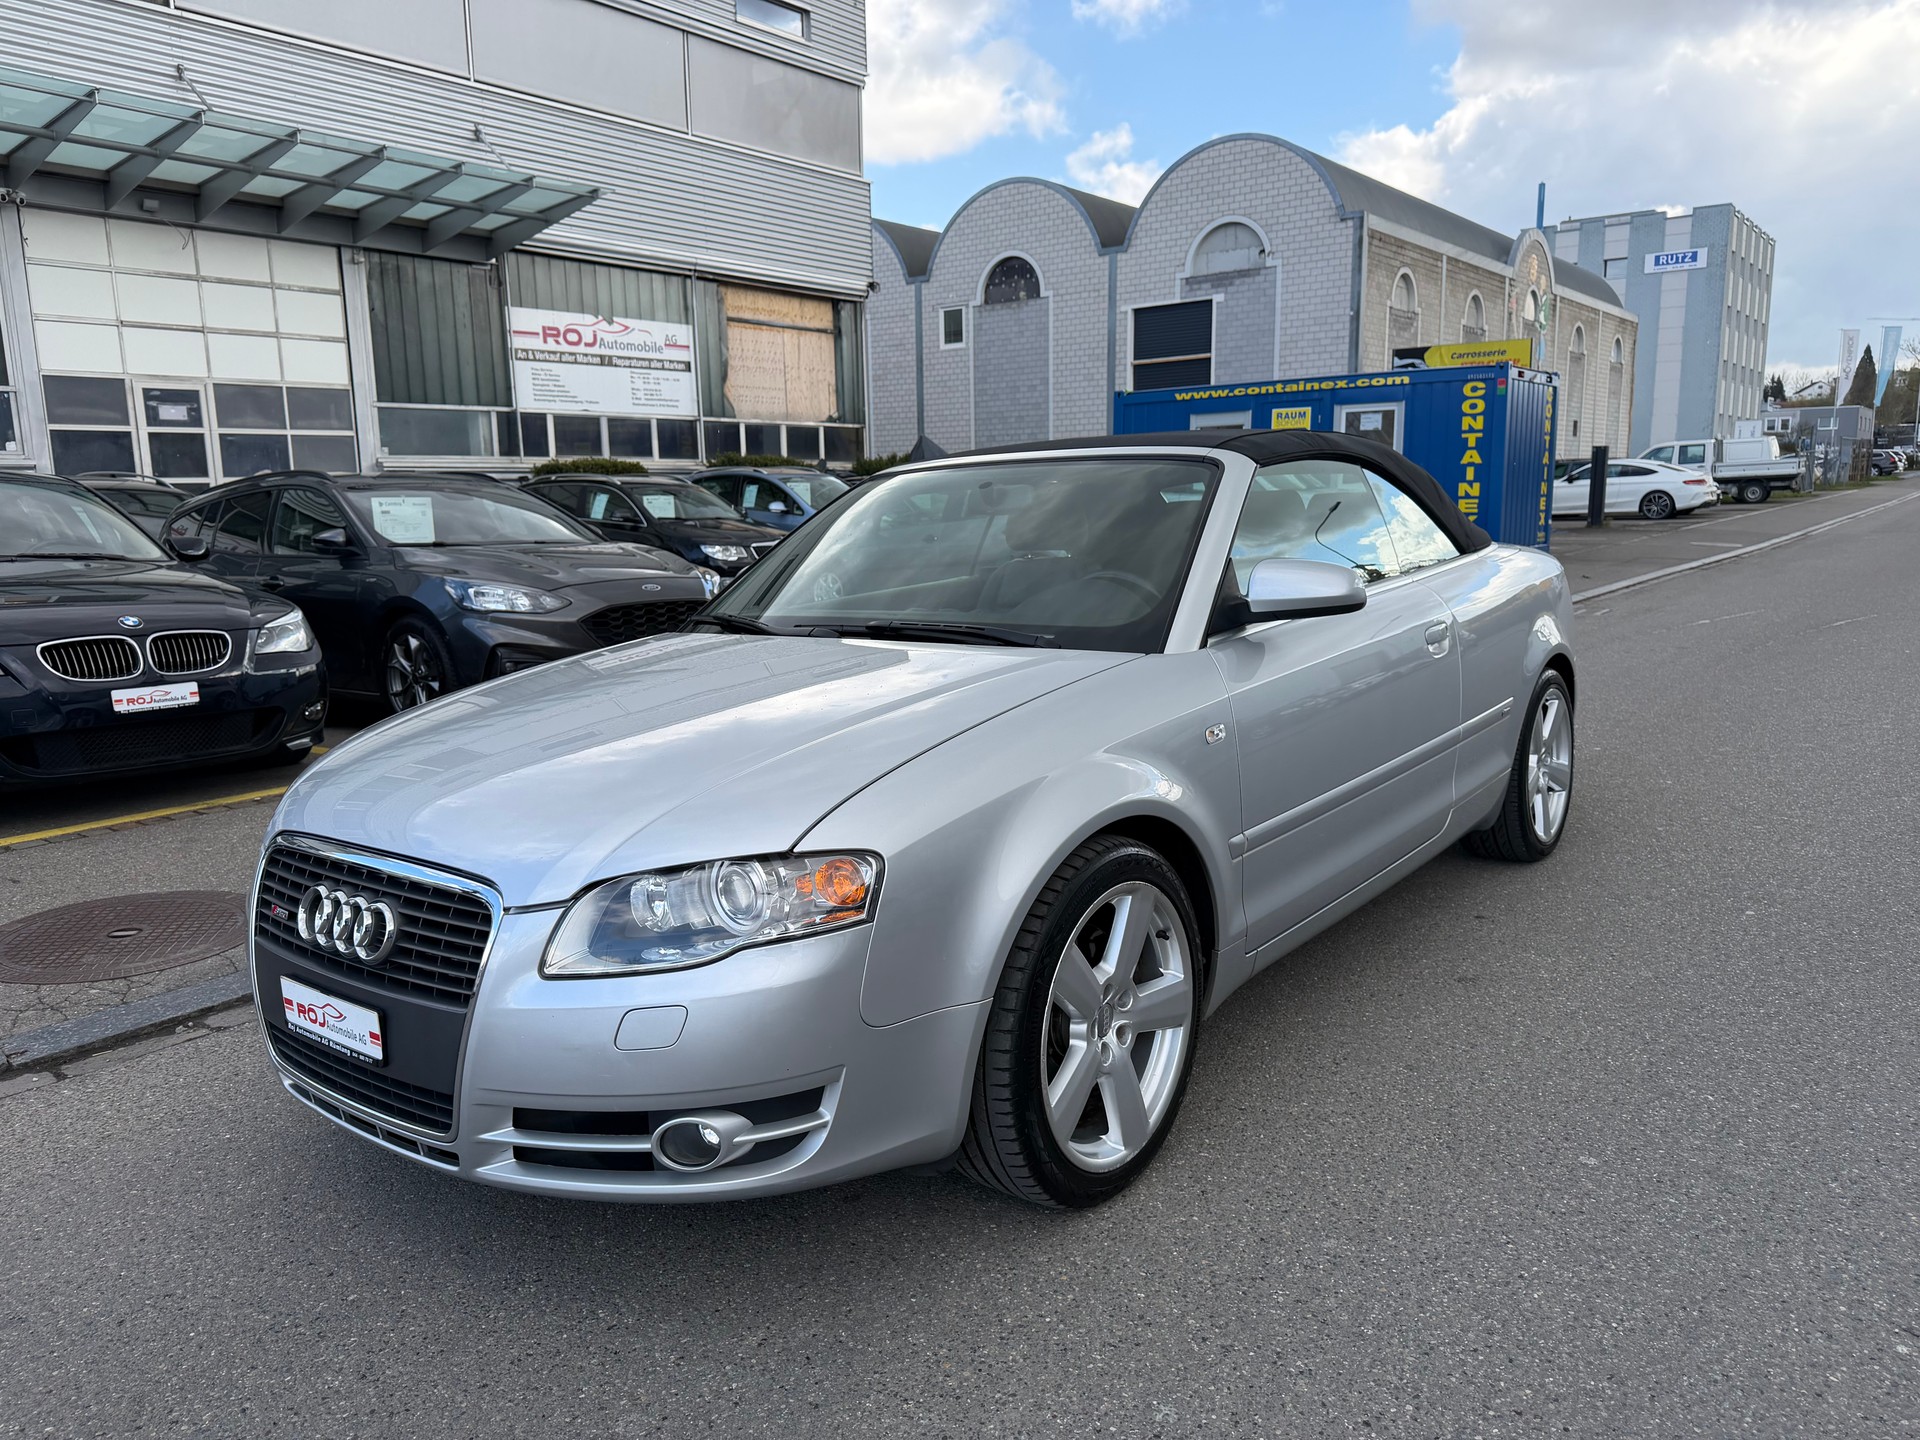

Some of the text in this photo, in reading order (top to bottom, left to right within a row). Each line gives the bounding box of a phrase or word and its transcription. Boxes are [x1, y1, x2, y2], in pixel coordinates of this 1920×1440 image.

[1659, 252, 1693, 265] RUTZ
[541, 325, 678, 354] ROJ Automobile AG
[517, 350, 527, 359] An
[528, 350, 534, 360] &
[534, 351, 560, 361] Verkauf
[561, 353, 575, 362] aller
[612, 357, 650, 368] Reparaturen
[650, 359, 663, 369] aller
[1450, 348, 1507, 360] Carrosserie
[1174, 375, 1410, 401] www.containex.com
[1276, 411, 1306, 420] RAUM
[1538, 386, 1554, 526] CONTAINEX
[126, 696, 154, 706] ROJ
[154, 696, 180, 704] Automobile
[288, 1022, 296, 1033] Roj
[296, 1026, 321, 1043] Automobile
[321, 1037, 329, 1046] AG
[296, 1001, 367, 1046] ROJ Automobile AG
